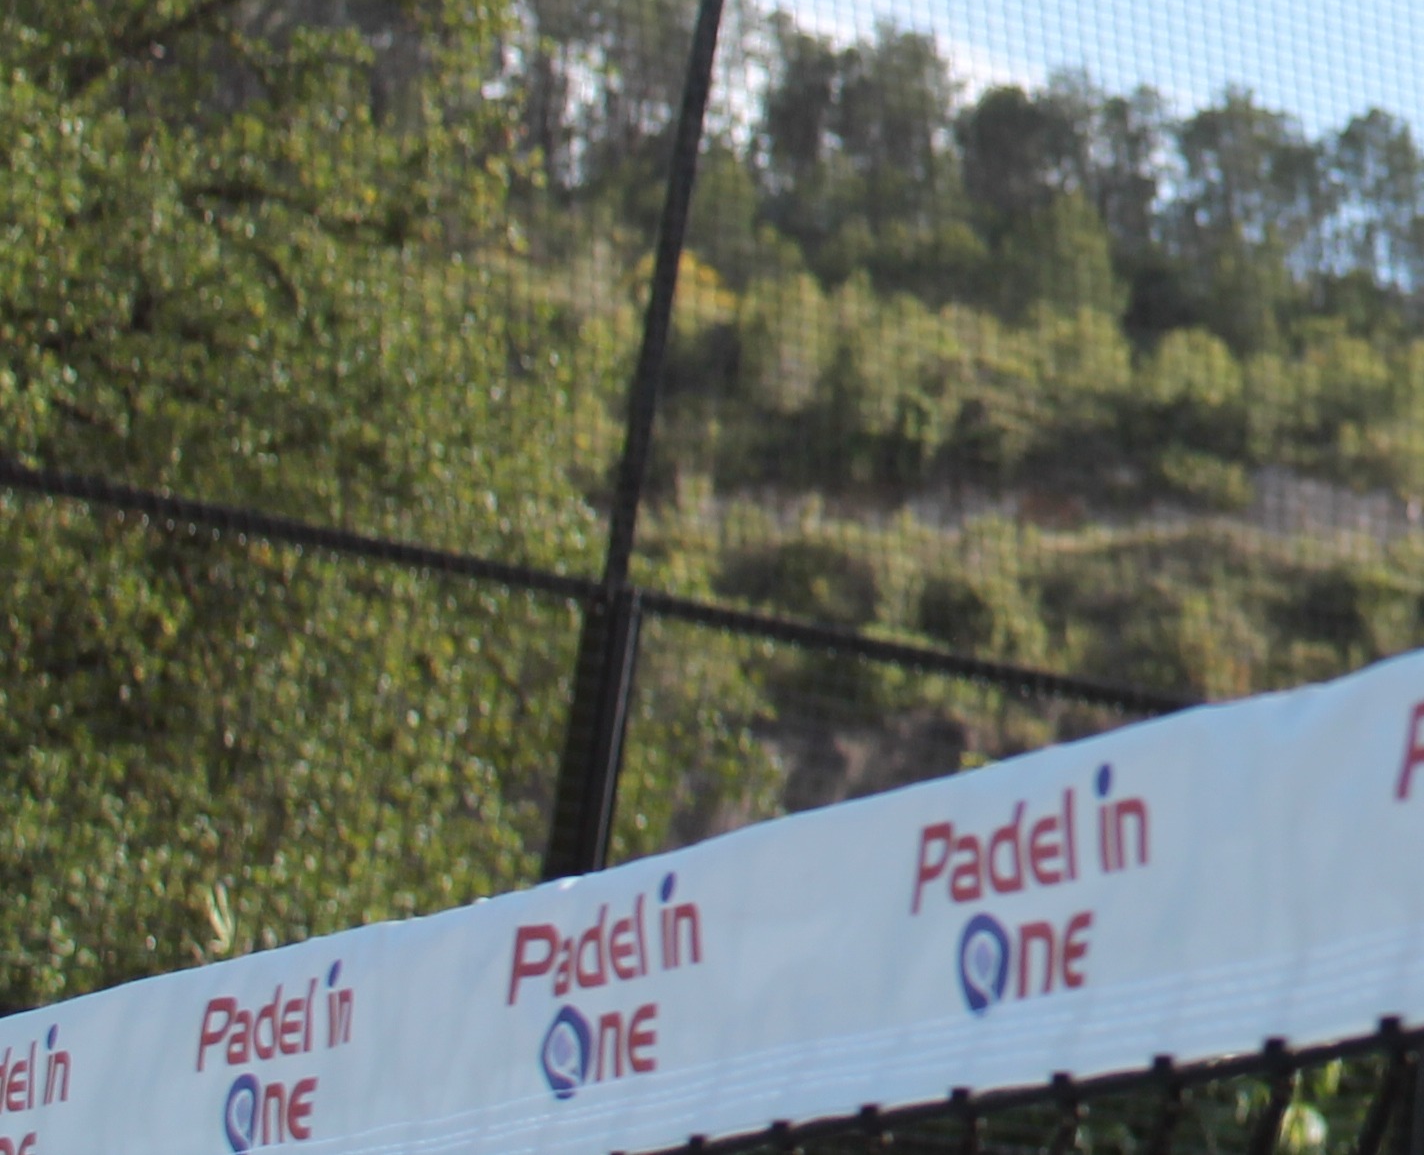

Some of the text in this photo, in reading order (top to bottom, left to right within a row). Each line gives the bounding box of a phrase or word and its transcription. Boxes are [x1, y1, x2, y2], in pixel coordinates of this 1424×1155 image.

[909, 762, 1148, 917] Padel in
[506, 872, 702, 1006] Padel in
[43, 1023, 72, 1106] in
[196, 959, 354, 1073] Padel in
